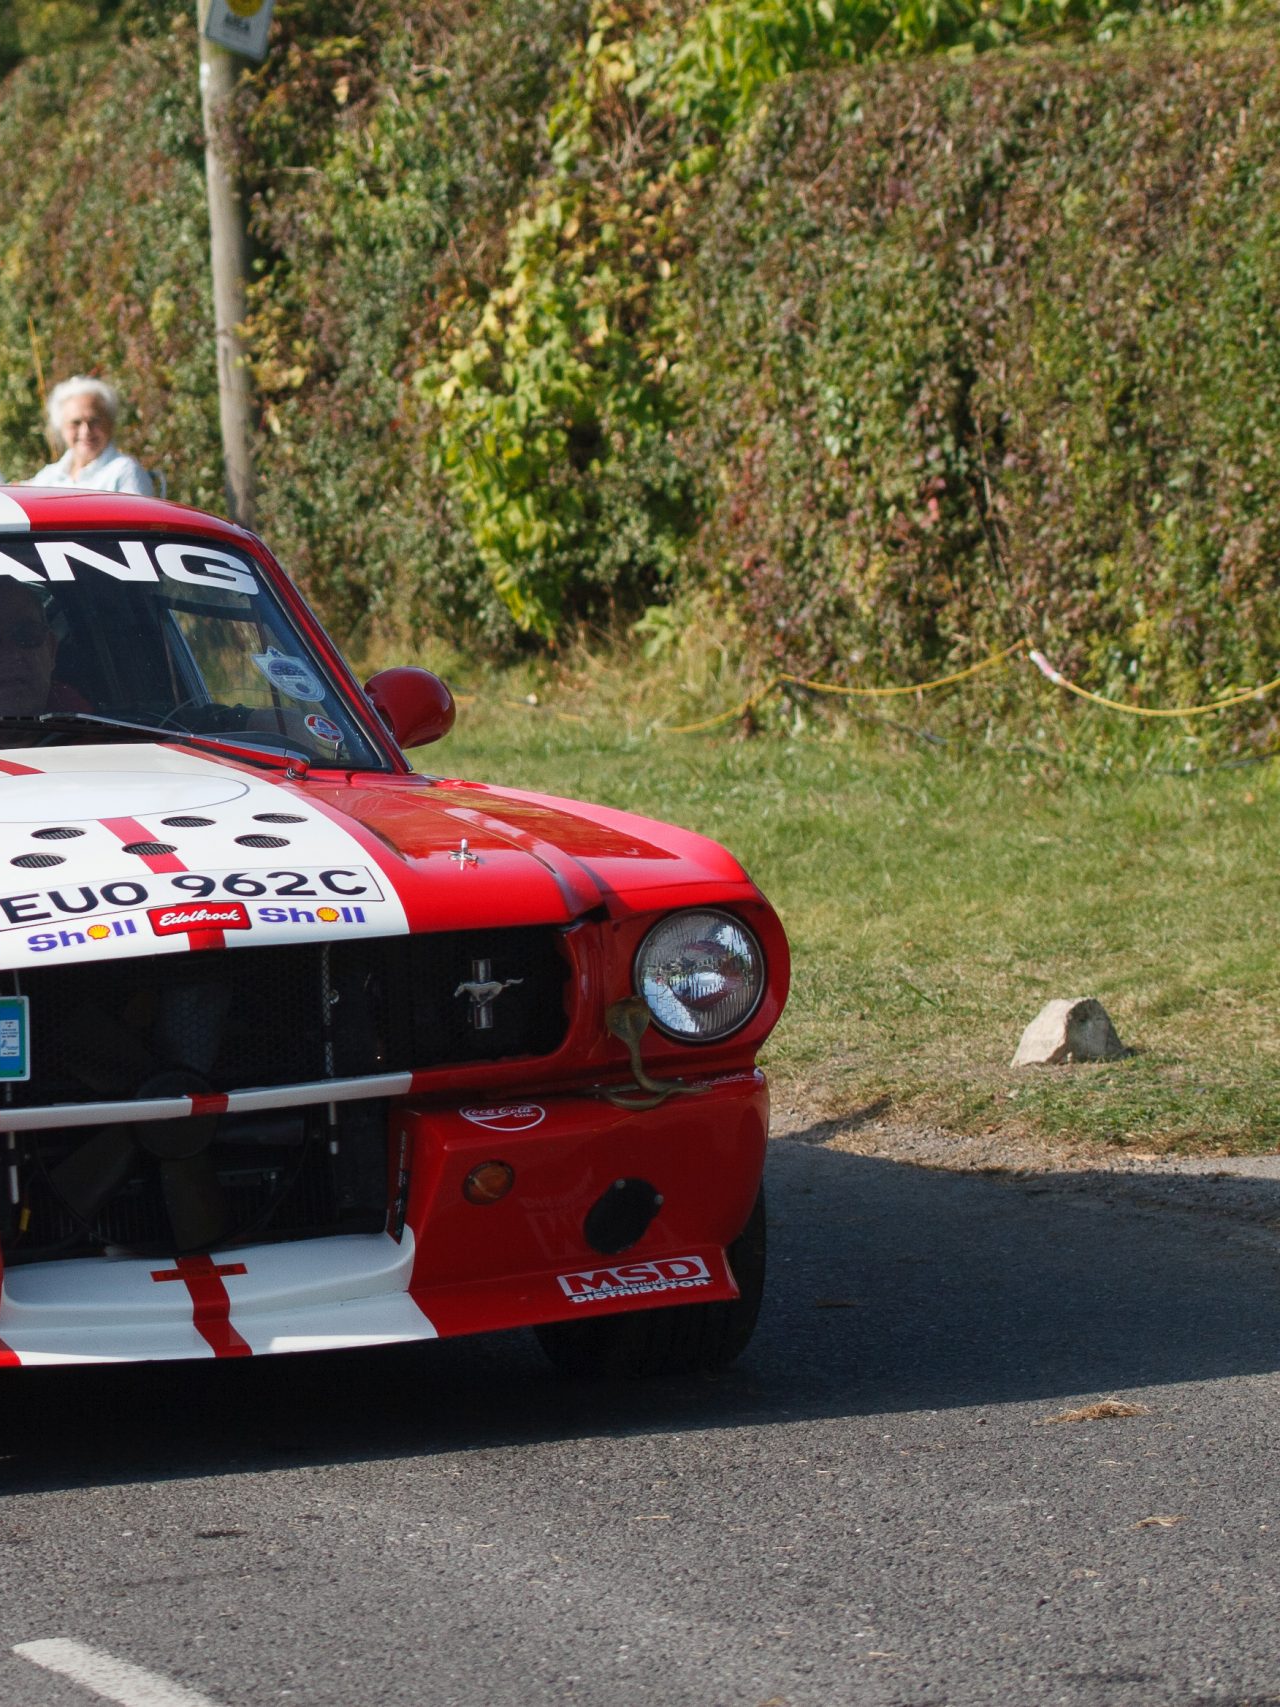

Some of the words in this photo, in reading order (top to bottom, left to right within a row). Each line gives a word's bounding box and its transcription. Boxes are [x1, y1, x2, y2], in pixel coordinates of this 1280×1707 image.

[171, 869, 368, 899] 962C
[158, 908, 241, 928] Edelbrock
[258, 906, 366, 924] Shll
[27, 919, 138, 952] Shll
[563, 1259, 702, 1294] MSD
[570, 1279, 710, 1303] DISTRIBUTOR
